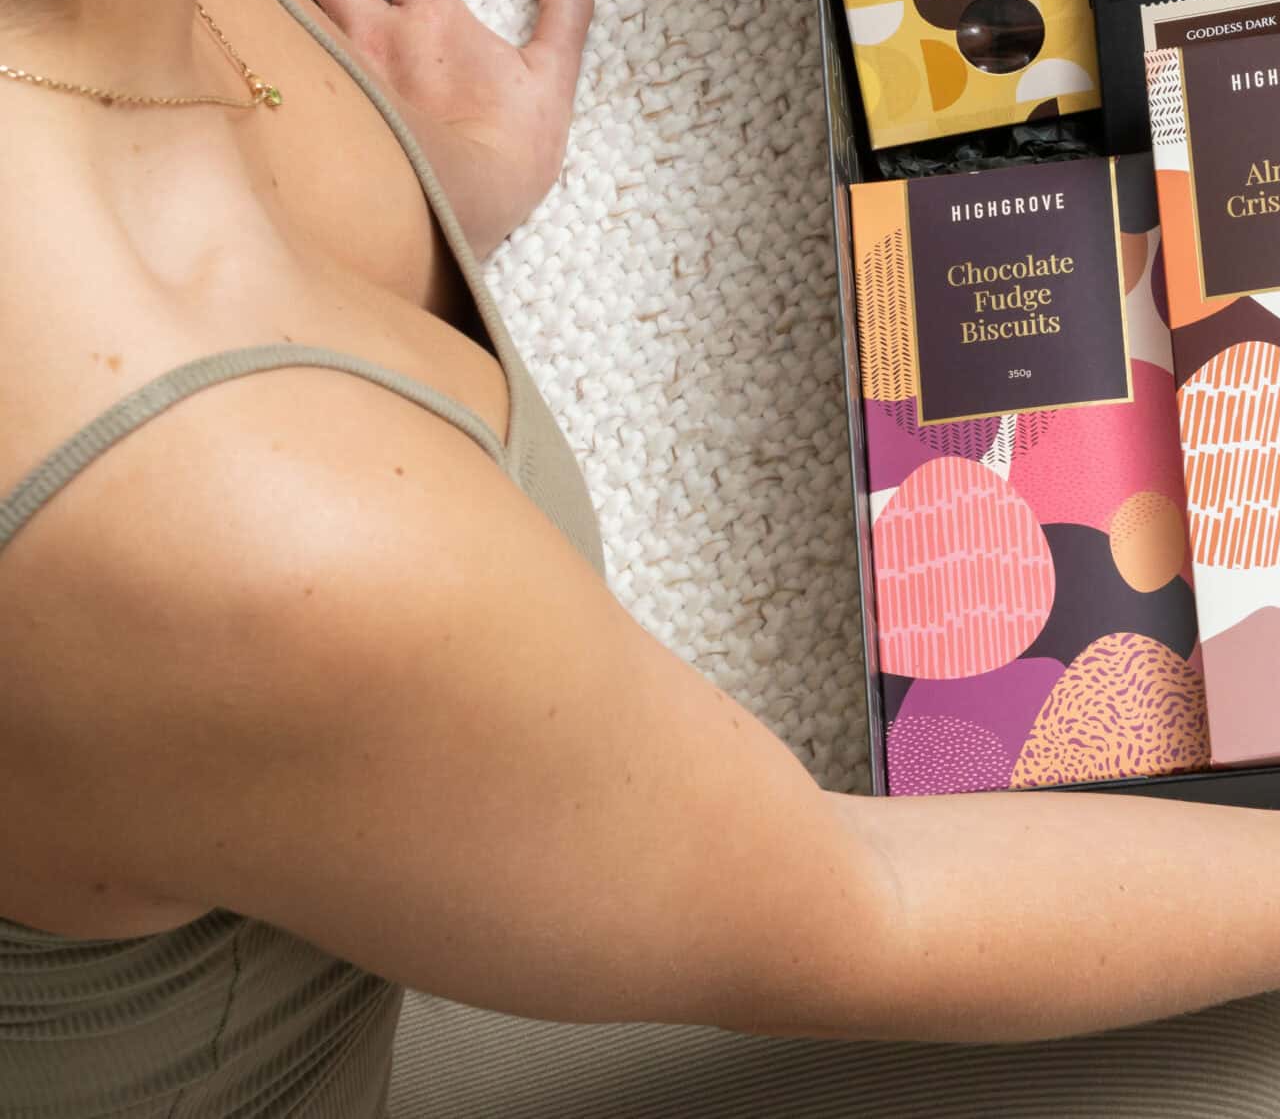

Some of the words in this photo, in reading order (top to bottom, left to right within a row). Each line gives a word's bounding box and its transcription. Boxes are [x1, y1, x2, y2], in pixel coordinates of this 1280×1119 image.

[1186, 22, 1243, 41] GODDESS
[1245, 15, 1278, 31] DARK
[952, 192, 1066, 222] HIGHGROVE
[947, 254, 1075, 287] Chocolate
[974, 285, 1053, 313] Fudge
[960, 313, 1062, 344] Biscuits
[1007, 368, 1032, 379] 350g
